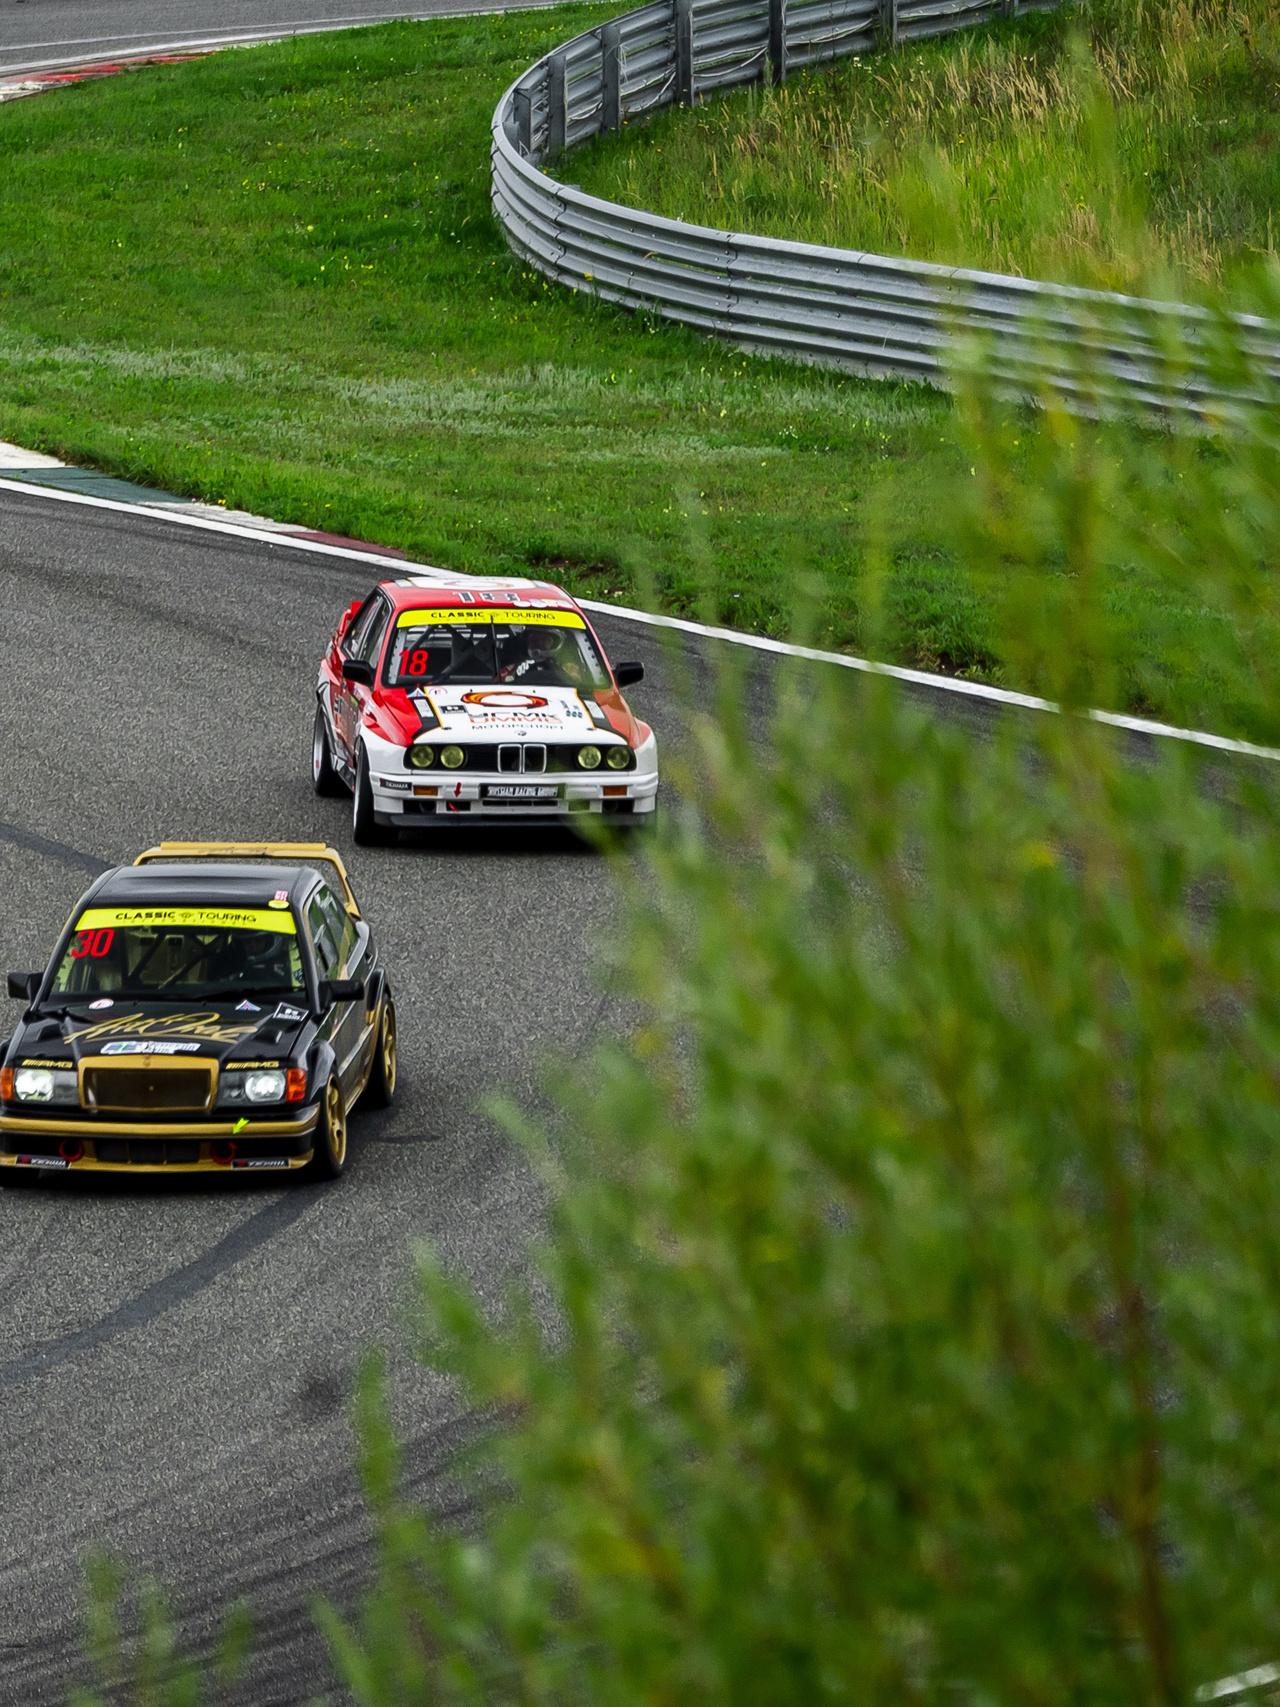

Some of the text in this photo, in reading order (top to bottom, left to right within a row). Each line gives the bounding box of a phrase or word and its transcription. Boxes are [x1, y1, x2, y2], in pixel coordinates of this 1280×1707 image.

[503, 611, 556, 620] TOURING
[399, 650, 429, 676] 18
[115, 911, 257, 922] CLASSIC TOURING
[71, 928, 114, 958] 30
